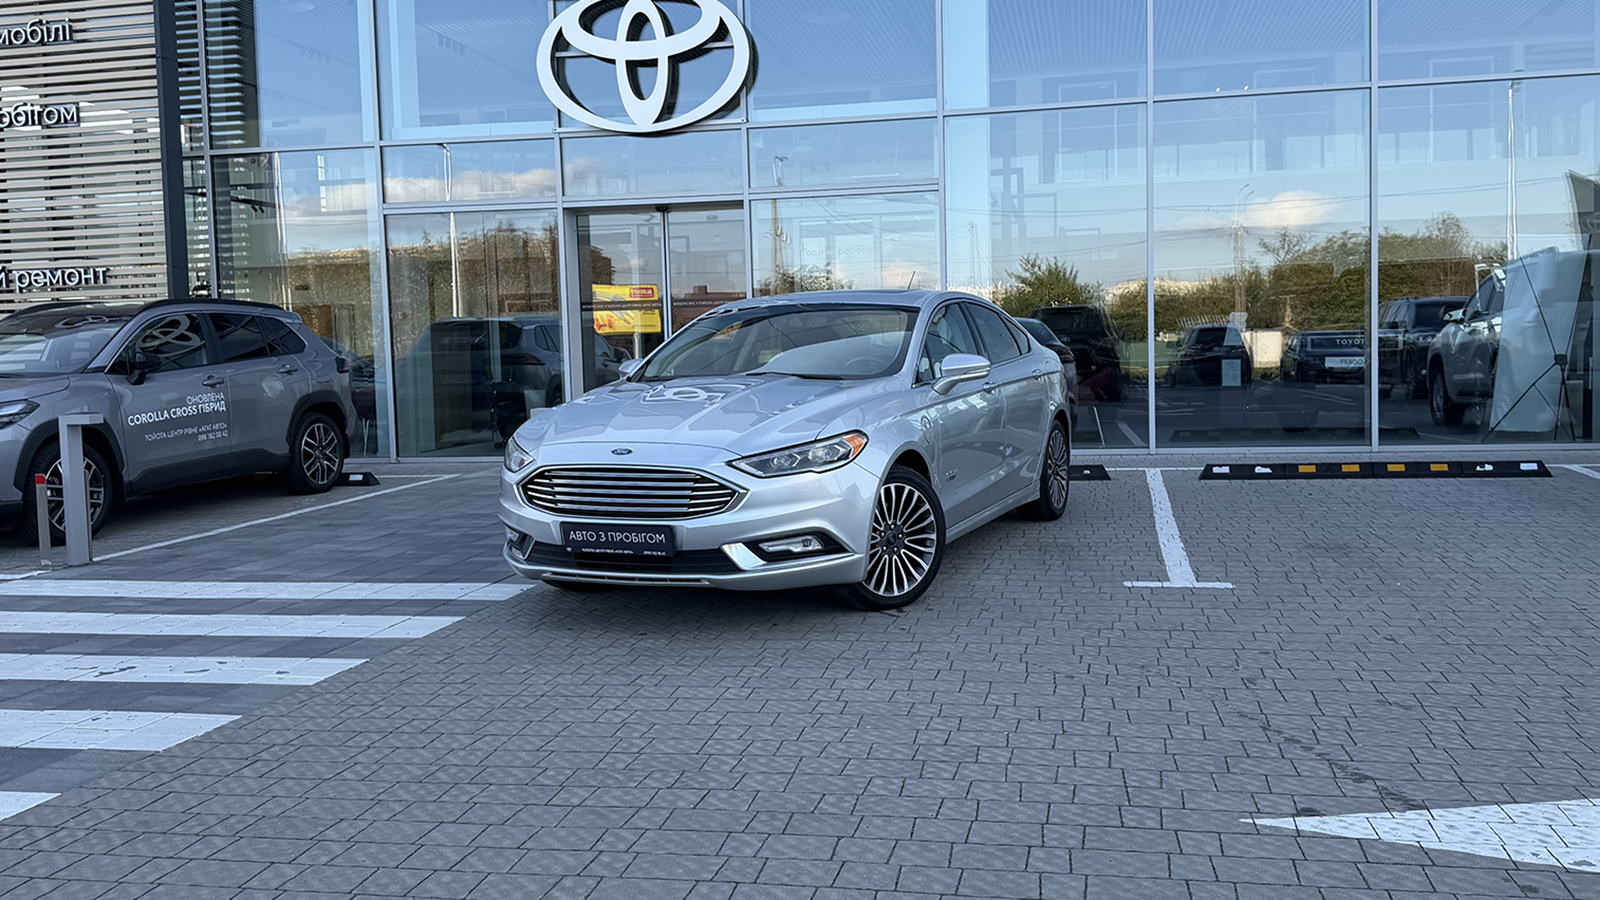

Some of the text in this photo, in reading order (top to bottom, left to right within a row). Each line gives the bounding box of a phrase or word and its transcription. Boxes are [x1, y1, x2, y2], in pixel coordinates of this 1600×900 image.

[12, 267, 107, 294] ремонт
[186, 392, 225, 405] ОНОВЛЕНА
[127, 401, 227, 426] COROLLA CROSS ГІБРИД
[569, 530, 597, 542] АВТО
[607, 532, 666, 544] ПРОБІГОМ
